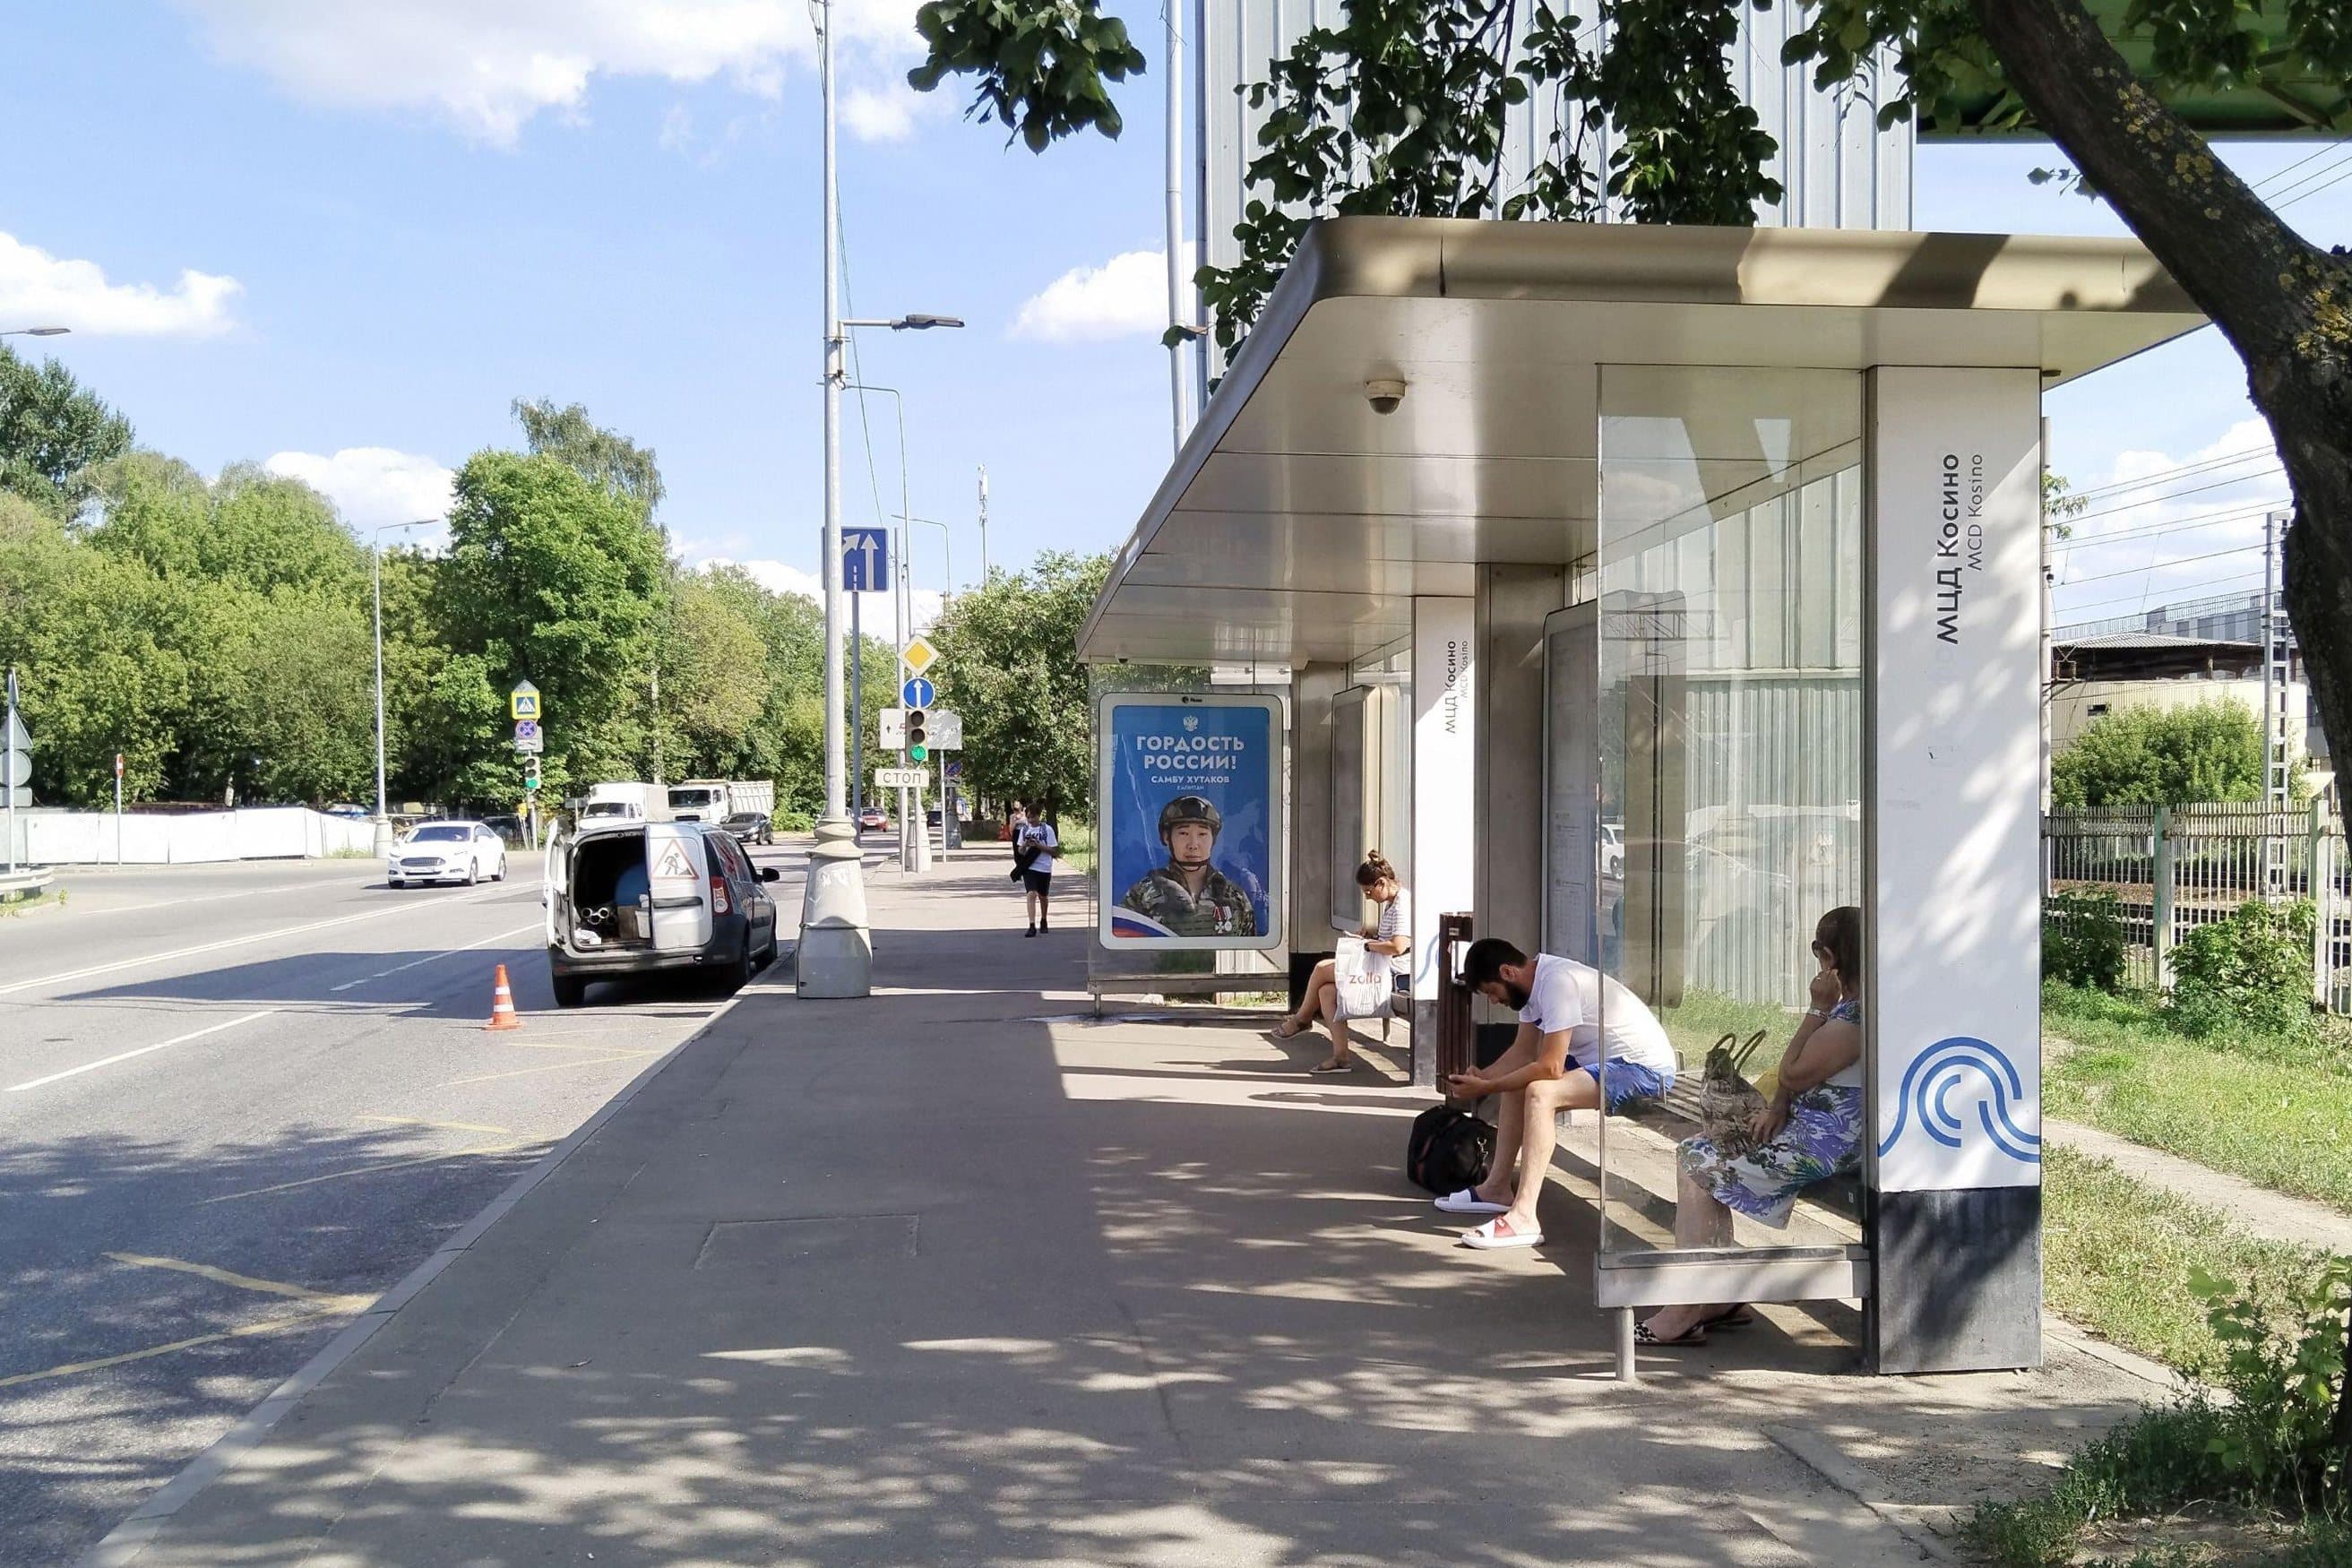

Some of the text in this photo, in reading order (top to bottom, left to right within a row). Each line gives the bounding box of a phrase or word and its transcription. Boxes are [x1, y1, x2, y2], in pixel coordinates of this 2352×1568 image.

[1967, 453, 1983, 571] MCD Kosino
[1936, 453, 1962, 644] МЦД Косино
[1460, 641, 1469, 673] Kosino
[1444, 641, 1459, 734] МЦД Косино
[1136, 736, 1245, 753] ГОРДОСТЬ
[1143, 754, 1237, 770] РОССИИ!
[883, 772, 921, 784] СТОП
[1150, 775, 1230, 784] САМБУ ХУТАКОВ
[1349, 971, 1382, 984] zolla
